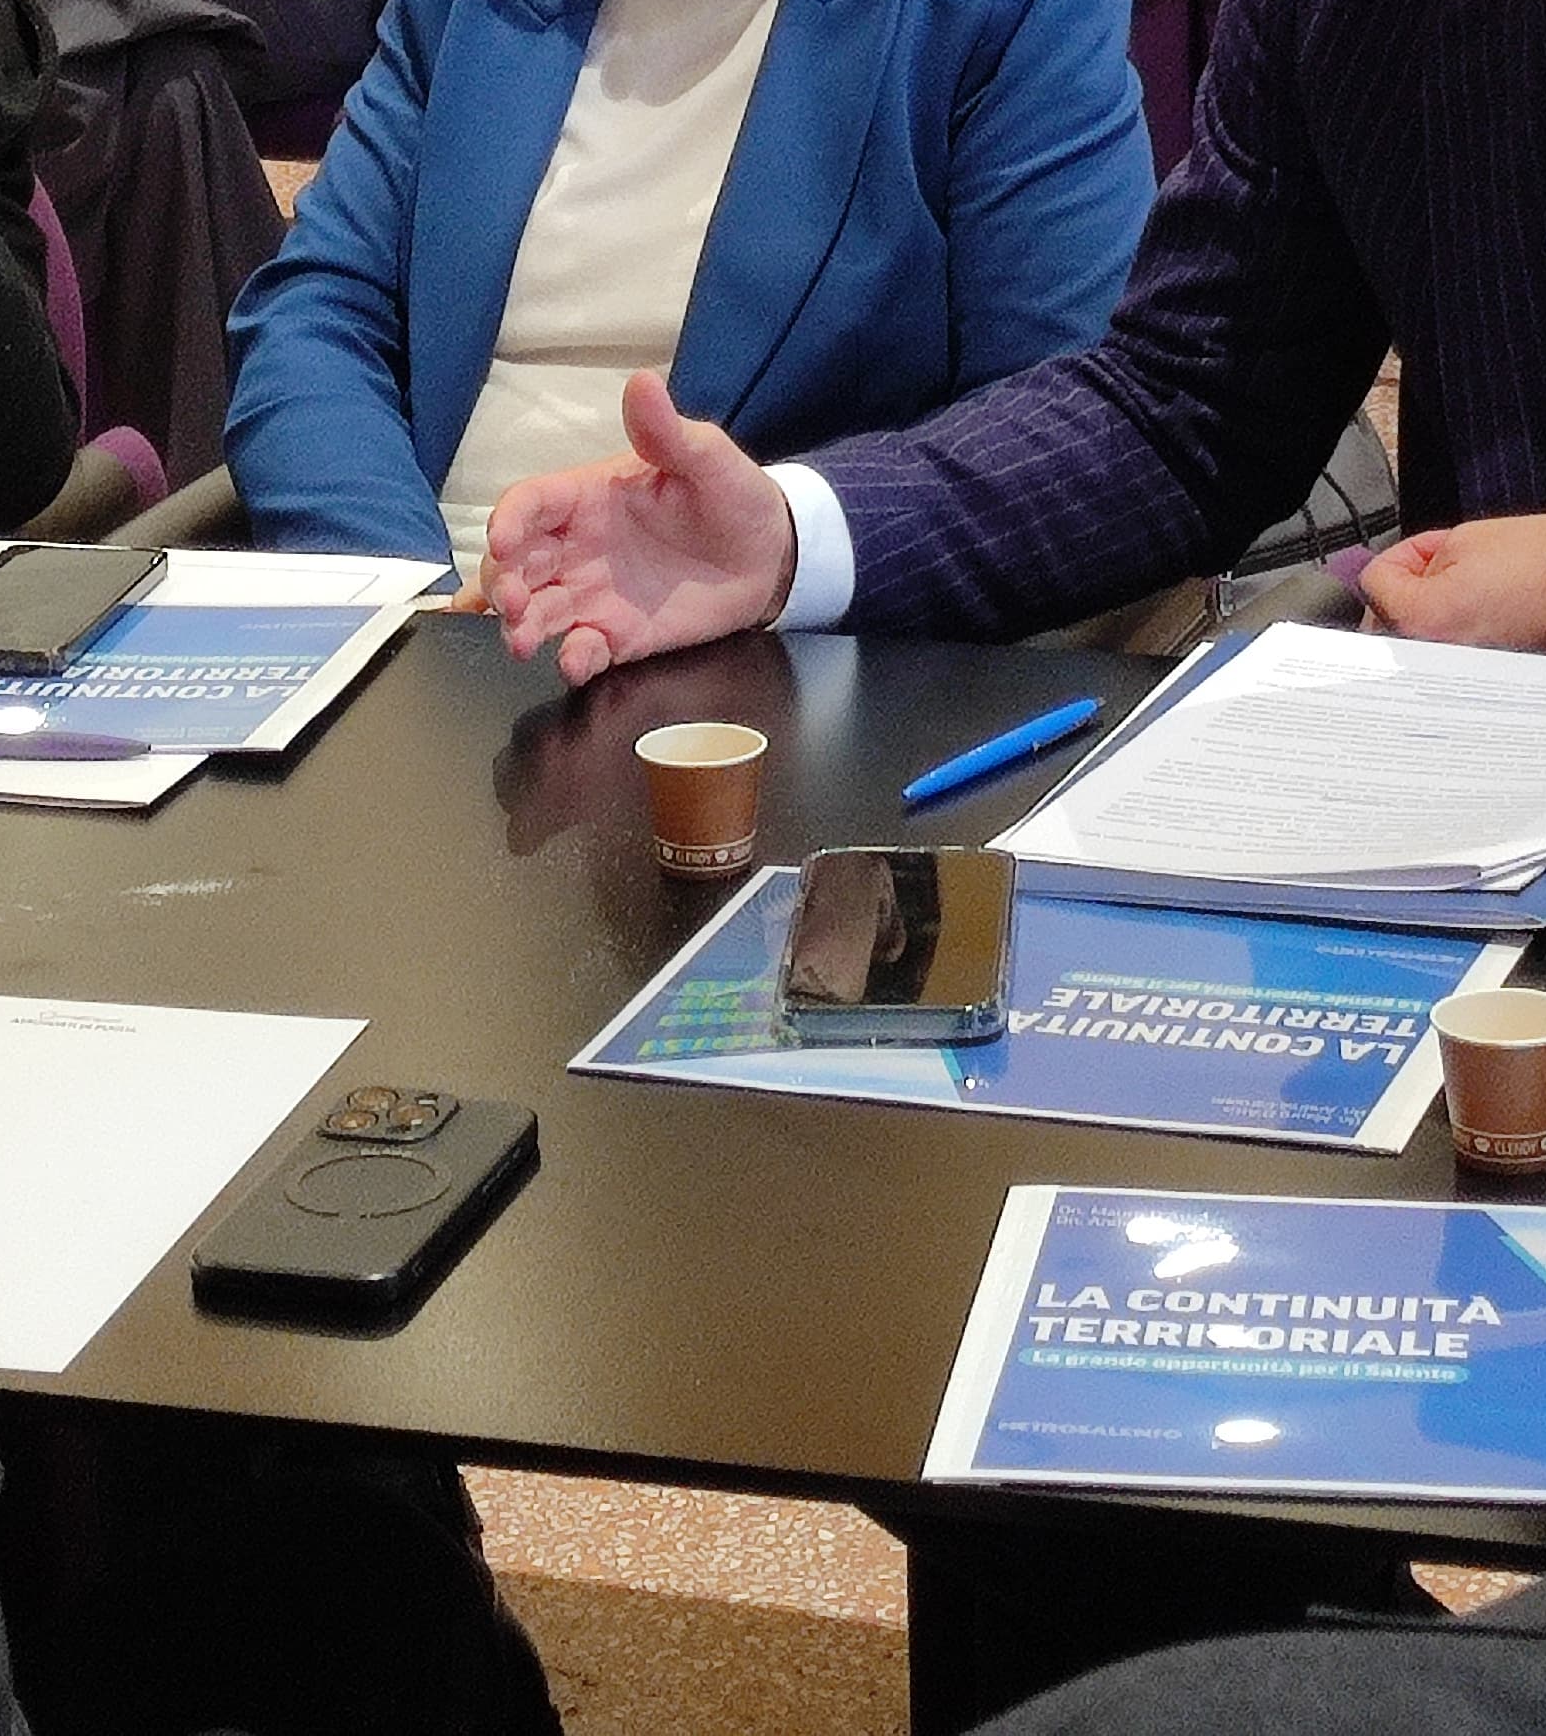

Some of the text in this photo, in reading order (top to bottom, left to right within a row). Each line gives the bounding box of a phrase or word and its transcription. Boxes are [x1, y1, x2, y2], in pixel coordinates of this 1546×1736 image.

[62, 664, 323, 681] TERRITORIA
[247, 684, 302, 700] LA
[1043, 987, 1417, 1038] TERRITORIALE
[1339, 1037, 1408, 1065] LA
[1036, 1283, 1502, 1326] LA CONTINUITÀ
[1028, 1316, 1470, 1359] TERRIORIALE
[1032, 1349, 1060, 1365] La
[1065, 1352, 1147, 1370] grande
[1298, 1363, 1338, 1377] per
[1365, 1363, 1457, 1381] Salento
